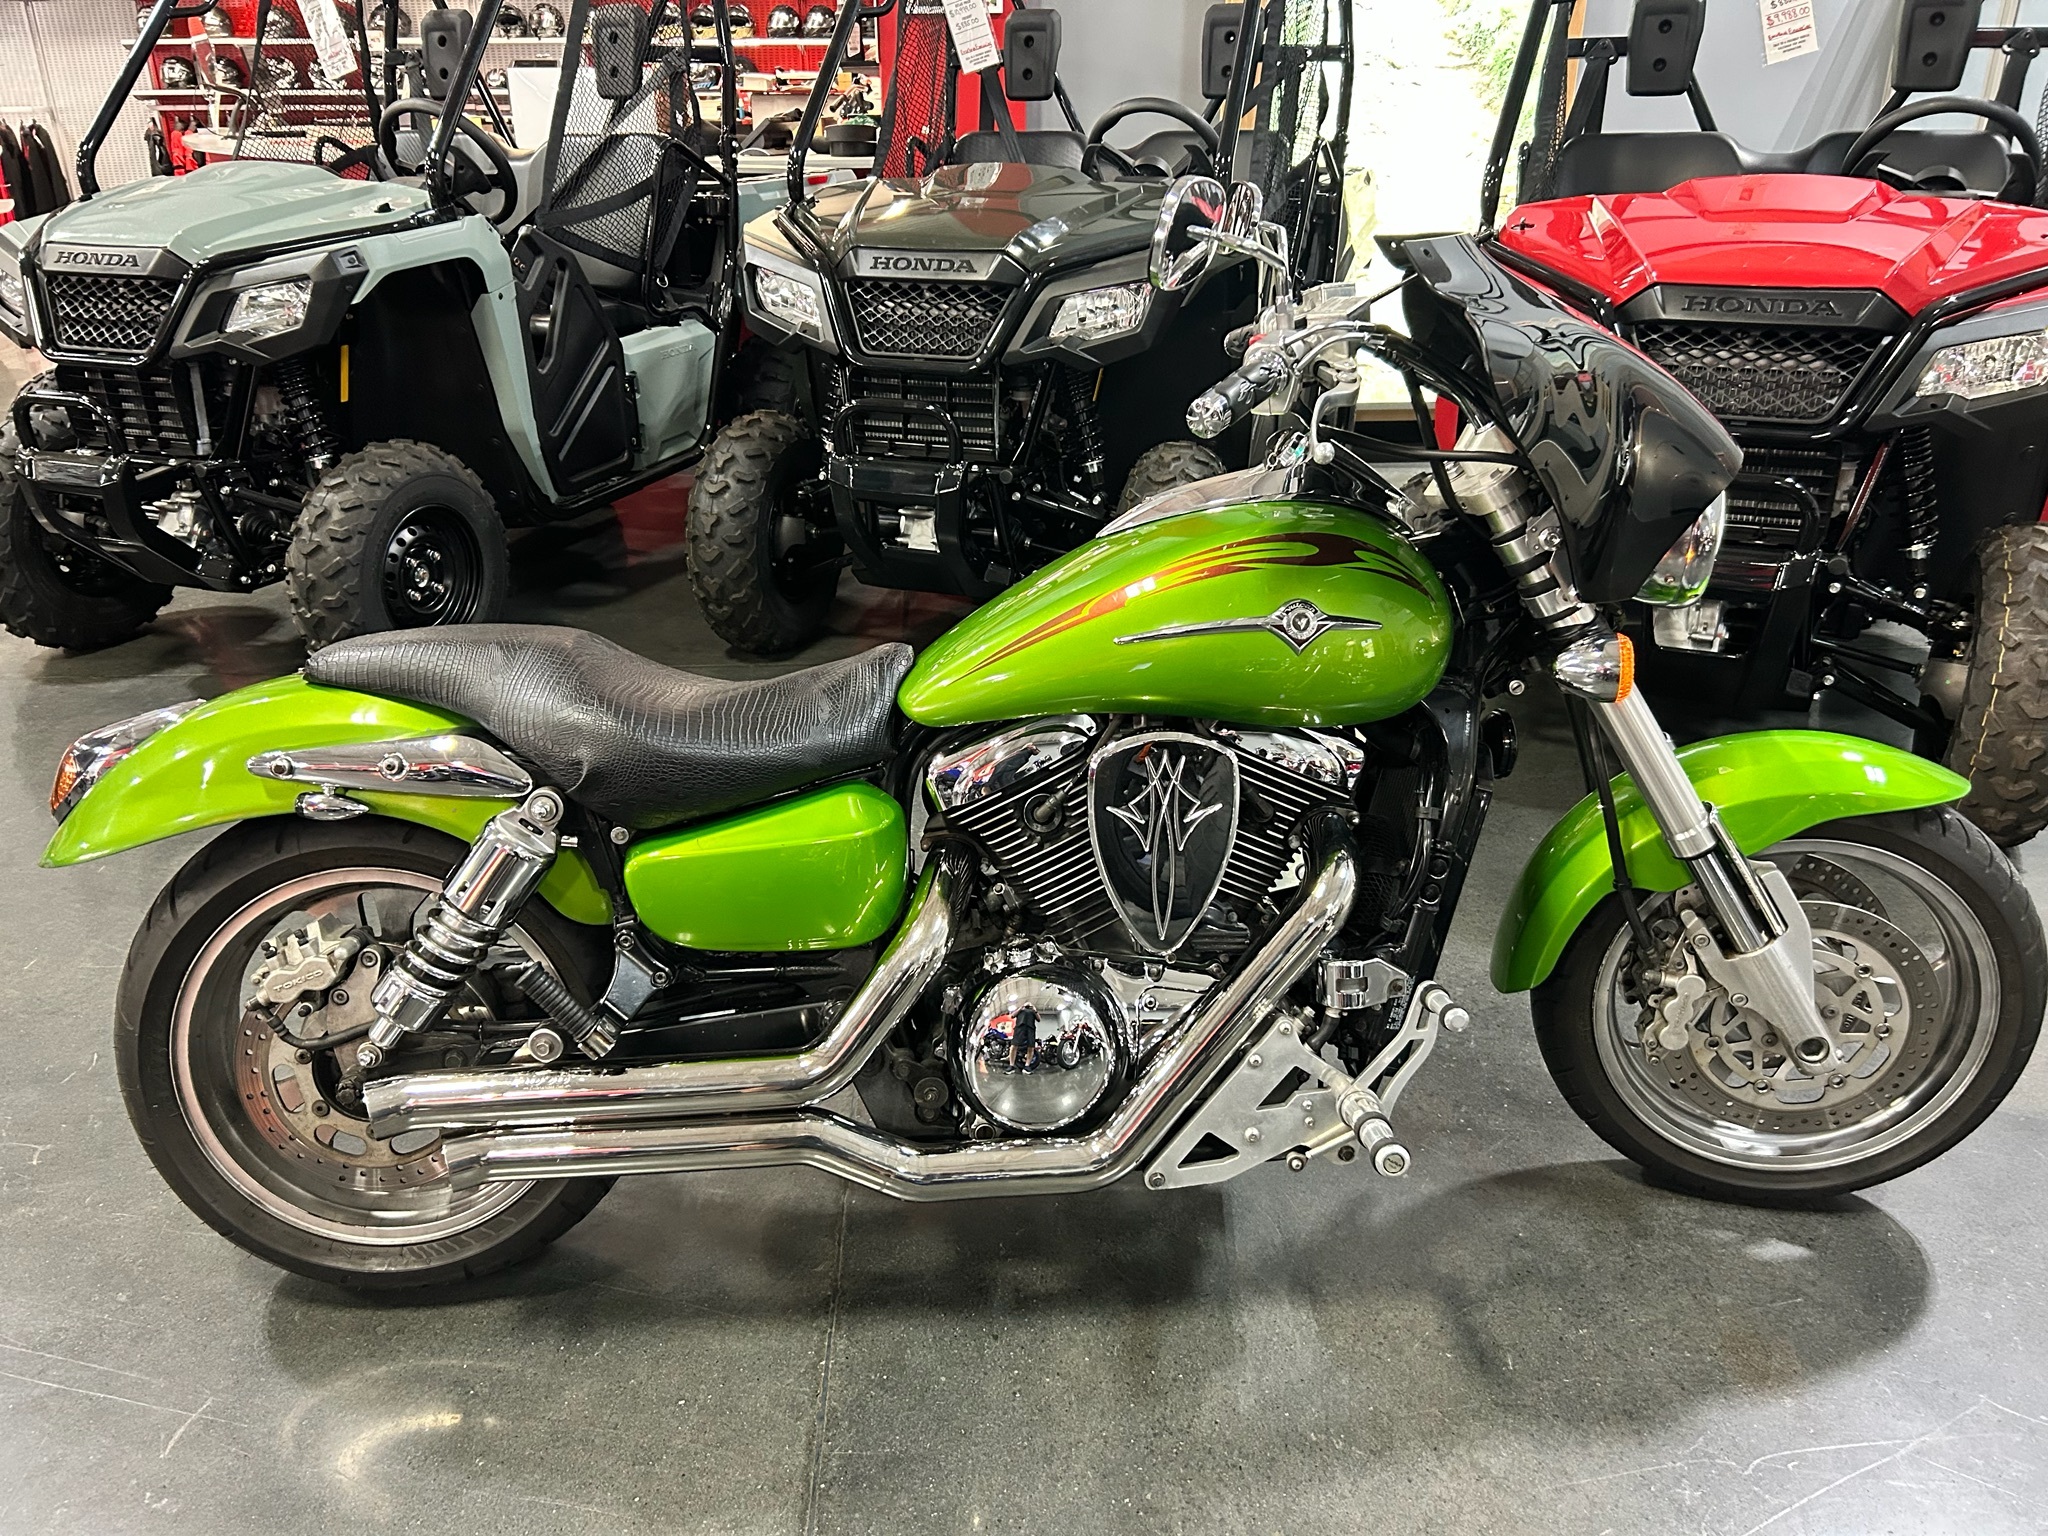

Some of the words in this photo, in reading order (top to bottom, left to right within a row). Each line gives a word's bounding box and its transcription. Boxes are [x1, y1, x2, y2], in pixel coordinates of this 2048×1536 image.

[54, 251, 140, 267] HONDA
[869, 256, 977, 273] HONDA
[1681, 295, 1843, 317] HONDA
[660, 343, 698, 360] HONDA
[273, 969, 323, 992] TOKICO
